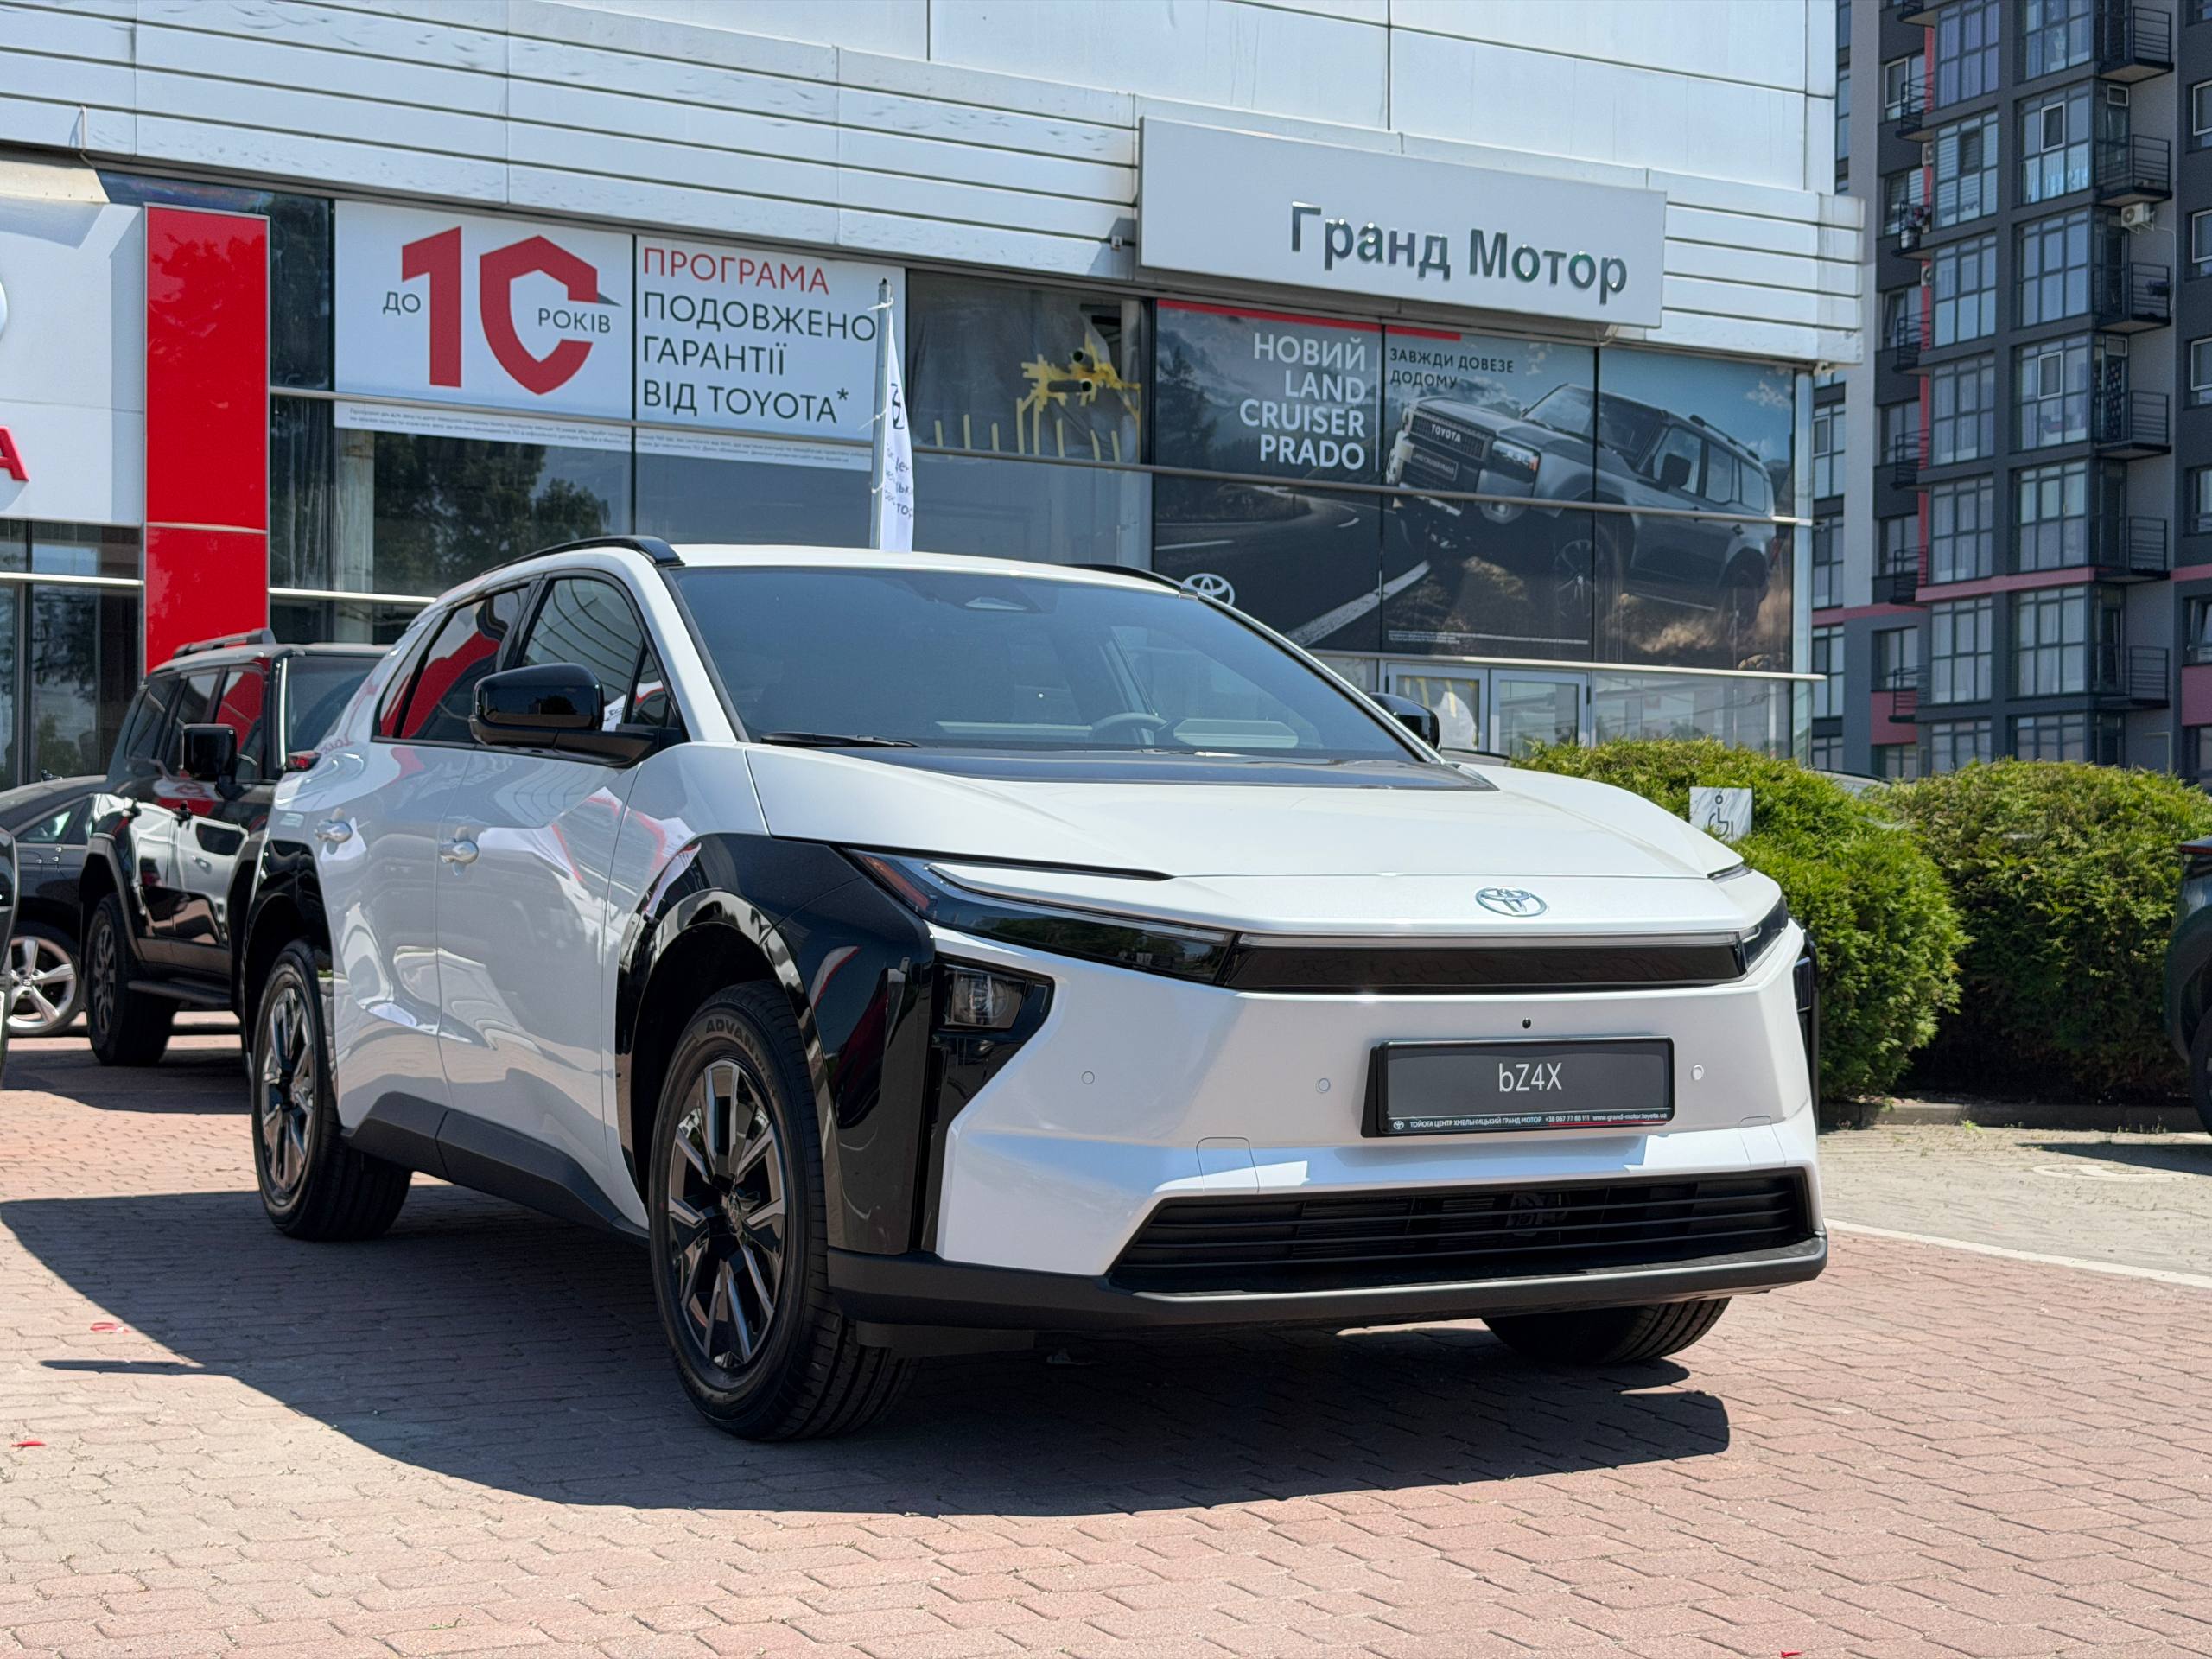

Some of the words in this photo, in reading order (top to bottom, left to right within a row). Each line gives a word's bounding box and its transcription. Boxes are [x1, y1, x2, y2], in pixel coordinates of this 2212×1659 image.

[1291, 200, 1451, 281] Гранд
[1469, 228, 1628, 305] Мотор
[644, 247, 830, 295] ПРОГРАМА
[383, 291, 422, 315] ДО
[537, 308, 612, 334] РОКІВ
[644, 335, 788, 375] ГАРАНТІЇ
[1253, 333, 1366, 372] НОВИЙ
[1389, 347, 1454, 368] ЗАВЖДИ
[1458, 355, 1515, 373] ДОВЕЗЕ
[644, 378, 698, 417] ВІД
[1284, 370, 1366, 404] LAND
[1389, 370, 1459, 389] ДОДОМУ
[1239, 398, 1366, 438] CRUISER
[1431, 424, 1462, 443] TOYOTA
[1260, 434, 1366, 470] PRADO
[705, 1018, 755, 1054] ADVAN
[1498, 1062, 1563, 1093] bZ4X
[1409, 1120, 1434, 1128] ТОЙОТА
[1433, 1120, 1453, 1128] ЦЕНТР
[1502, 1117, 1522, 1126] ГРАНД
[1521, 1116, 1541, 1124] МОТОР
